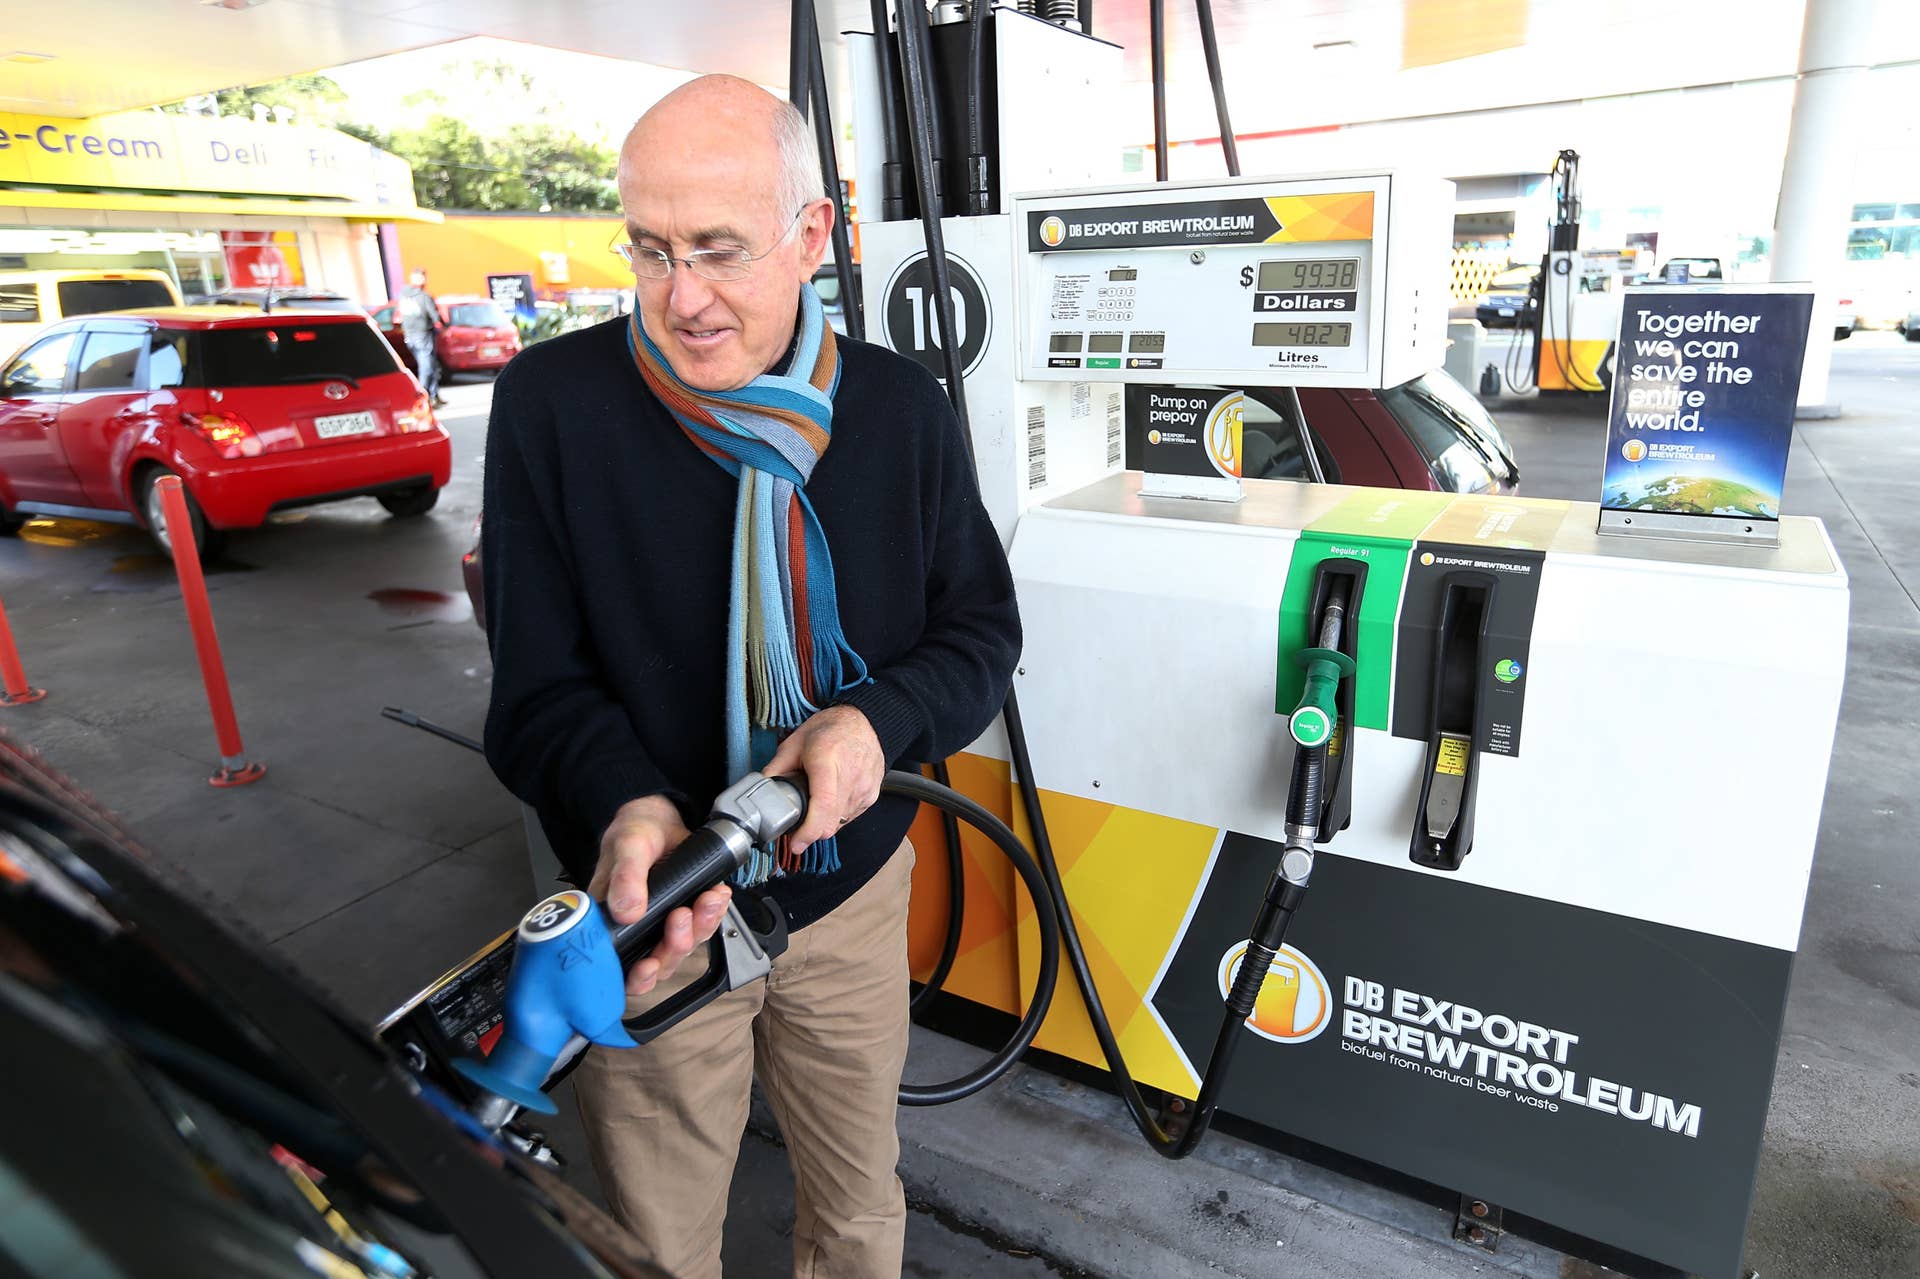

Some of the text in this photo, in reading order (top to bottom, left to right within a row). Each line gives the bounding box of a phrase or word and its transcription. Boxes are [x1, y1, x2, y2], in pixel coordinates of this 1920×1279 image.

[211, 140, 267, 164] Deli
[1069, 215, 1255, 237] DB EXPORT BREWTROLEUM
[1240, 265, 1254, 289] $
[1292, 262, 1356, 288] 99.38
[1263, 295, 1346, 310] Dollars
[906, 286, 966, 350] 10
[1637, 311, 1760, 338] Together
[1288, 325, 1349, 345] 48.27
[1278, 352, 1319, 362] Litres
[1634, 340, 1738, 358] we can
[1631, 362, 1752, 384] save the
[1150, 394, 1207, 410] Pump on
[1628, 385, 1705, 408] entire
[1150, 411, 1197, 425] prepay
[1626, 411, 1704, 432] world.
[1648, 451, 1715, 460] BREWTROLEUM
[1659, 444, 1695, 452] EXPORT
[1331, 546, 1369, 557] Regular 91
[1444, 557, 1473, 567] EXPORT
[1474, 561, 1531, 572] BREWTROLEUM
[1344, 975, 1579, 1064] DB EXPORT
[1341, 1040, 1559, 1112] biofuel from natural beer waste
[1342, 1008, 1702, 1138] BREWTROLEUM
